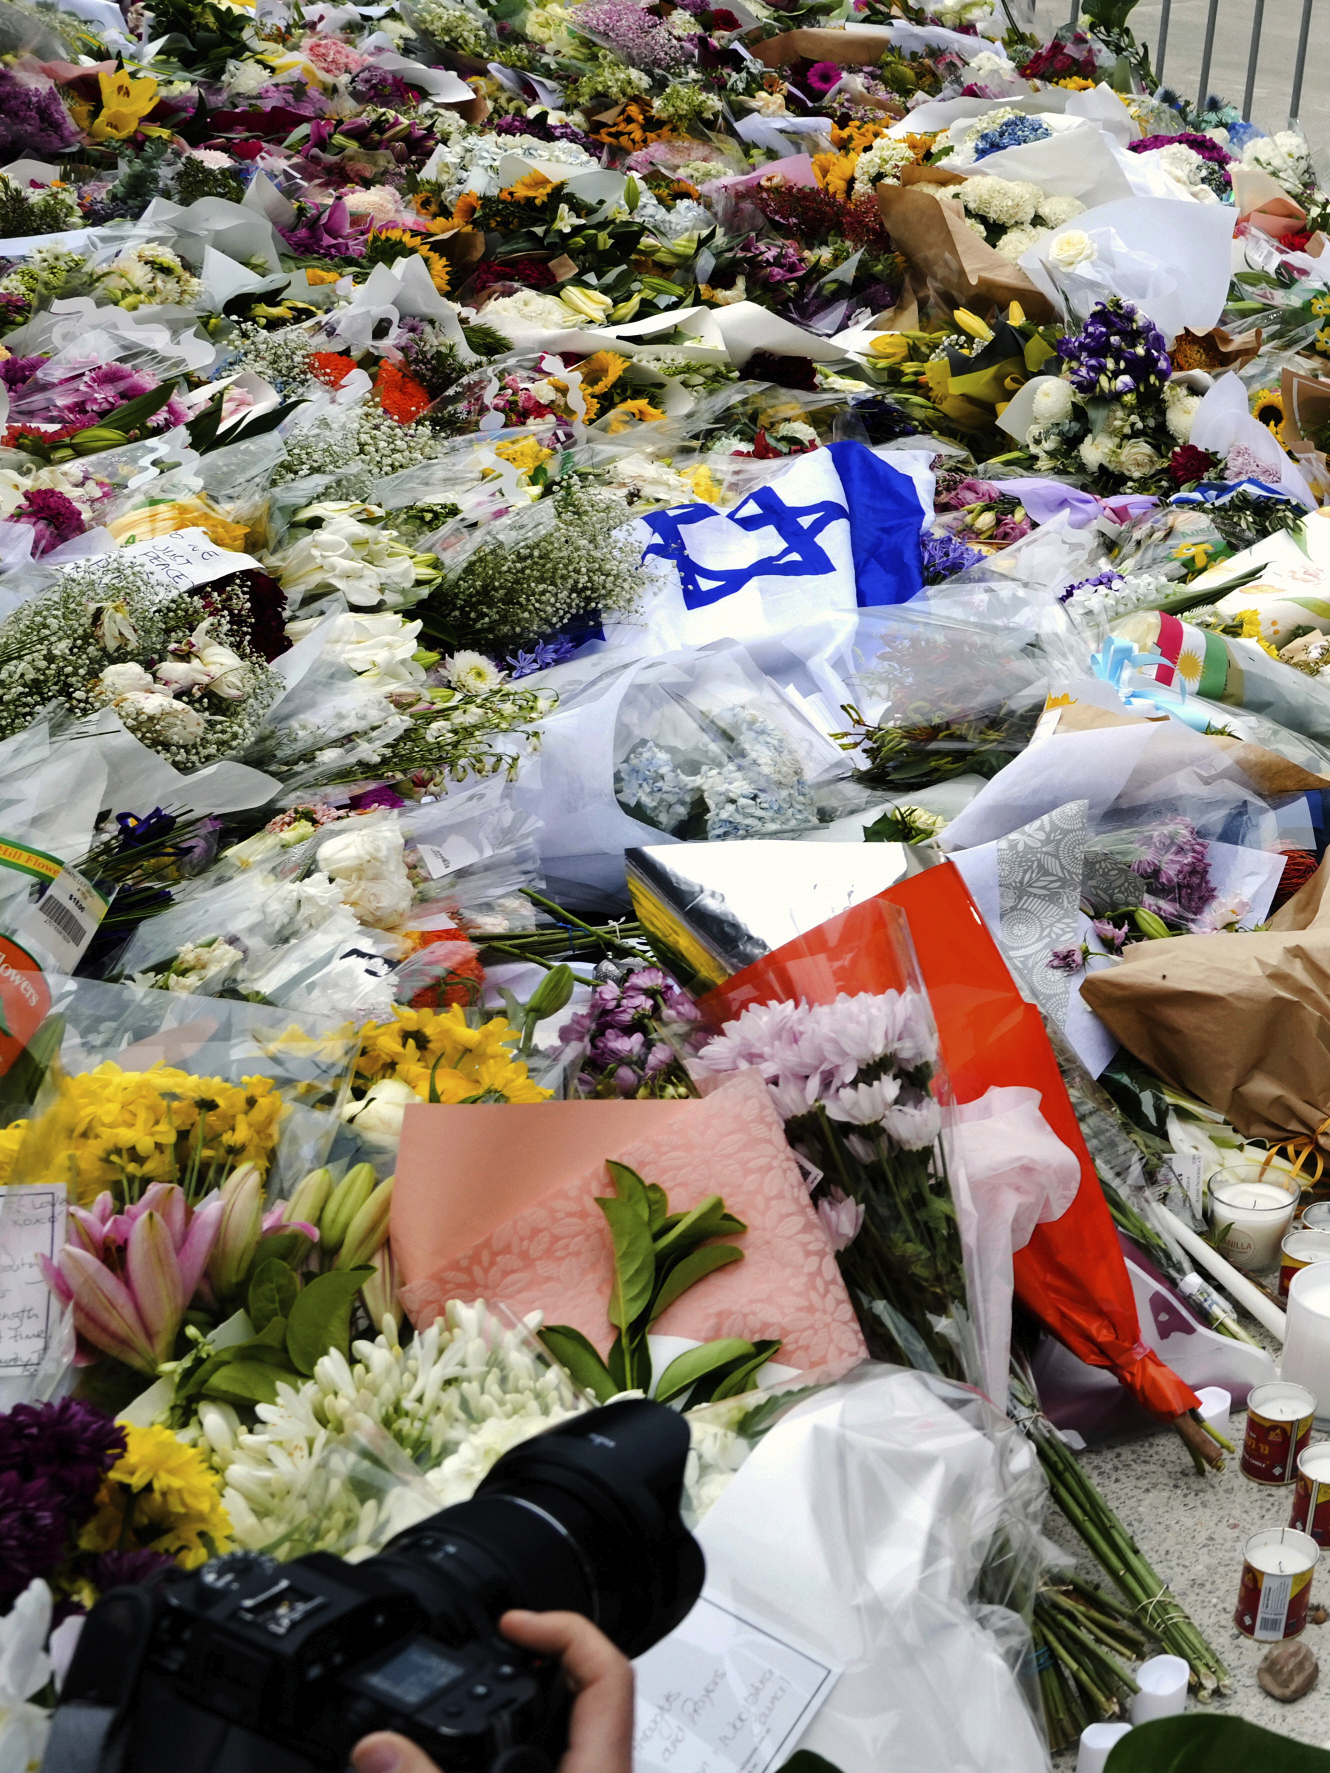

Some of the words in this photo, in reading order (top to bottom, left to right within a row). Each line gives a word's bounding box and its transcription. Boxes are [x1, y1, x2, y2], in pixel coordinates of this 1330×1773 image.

[0, 845, 22, 861] Hill
[25, 854, 60, 877] Flowe
[1223, 1239, 1252, 1251] ANILLA
